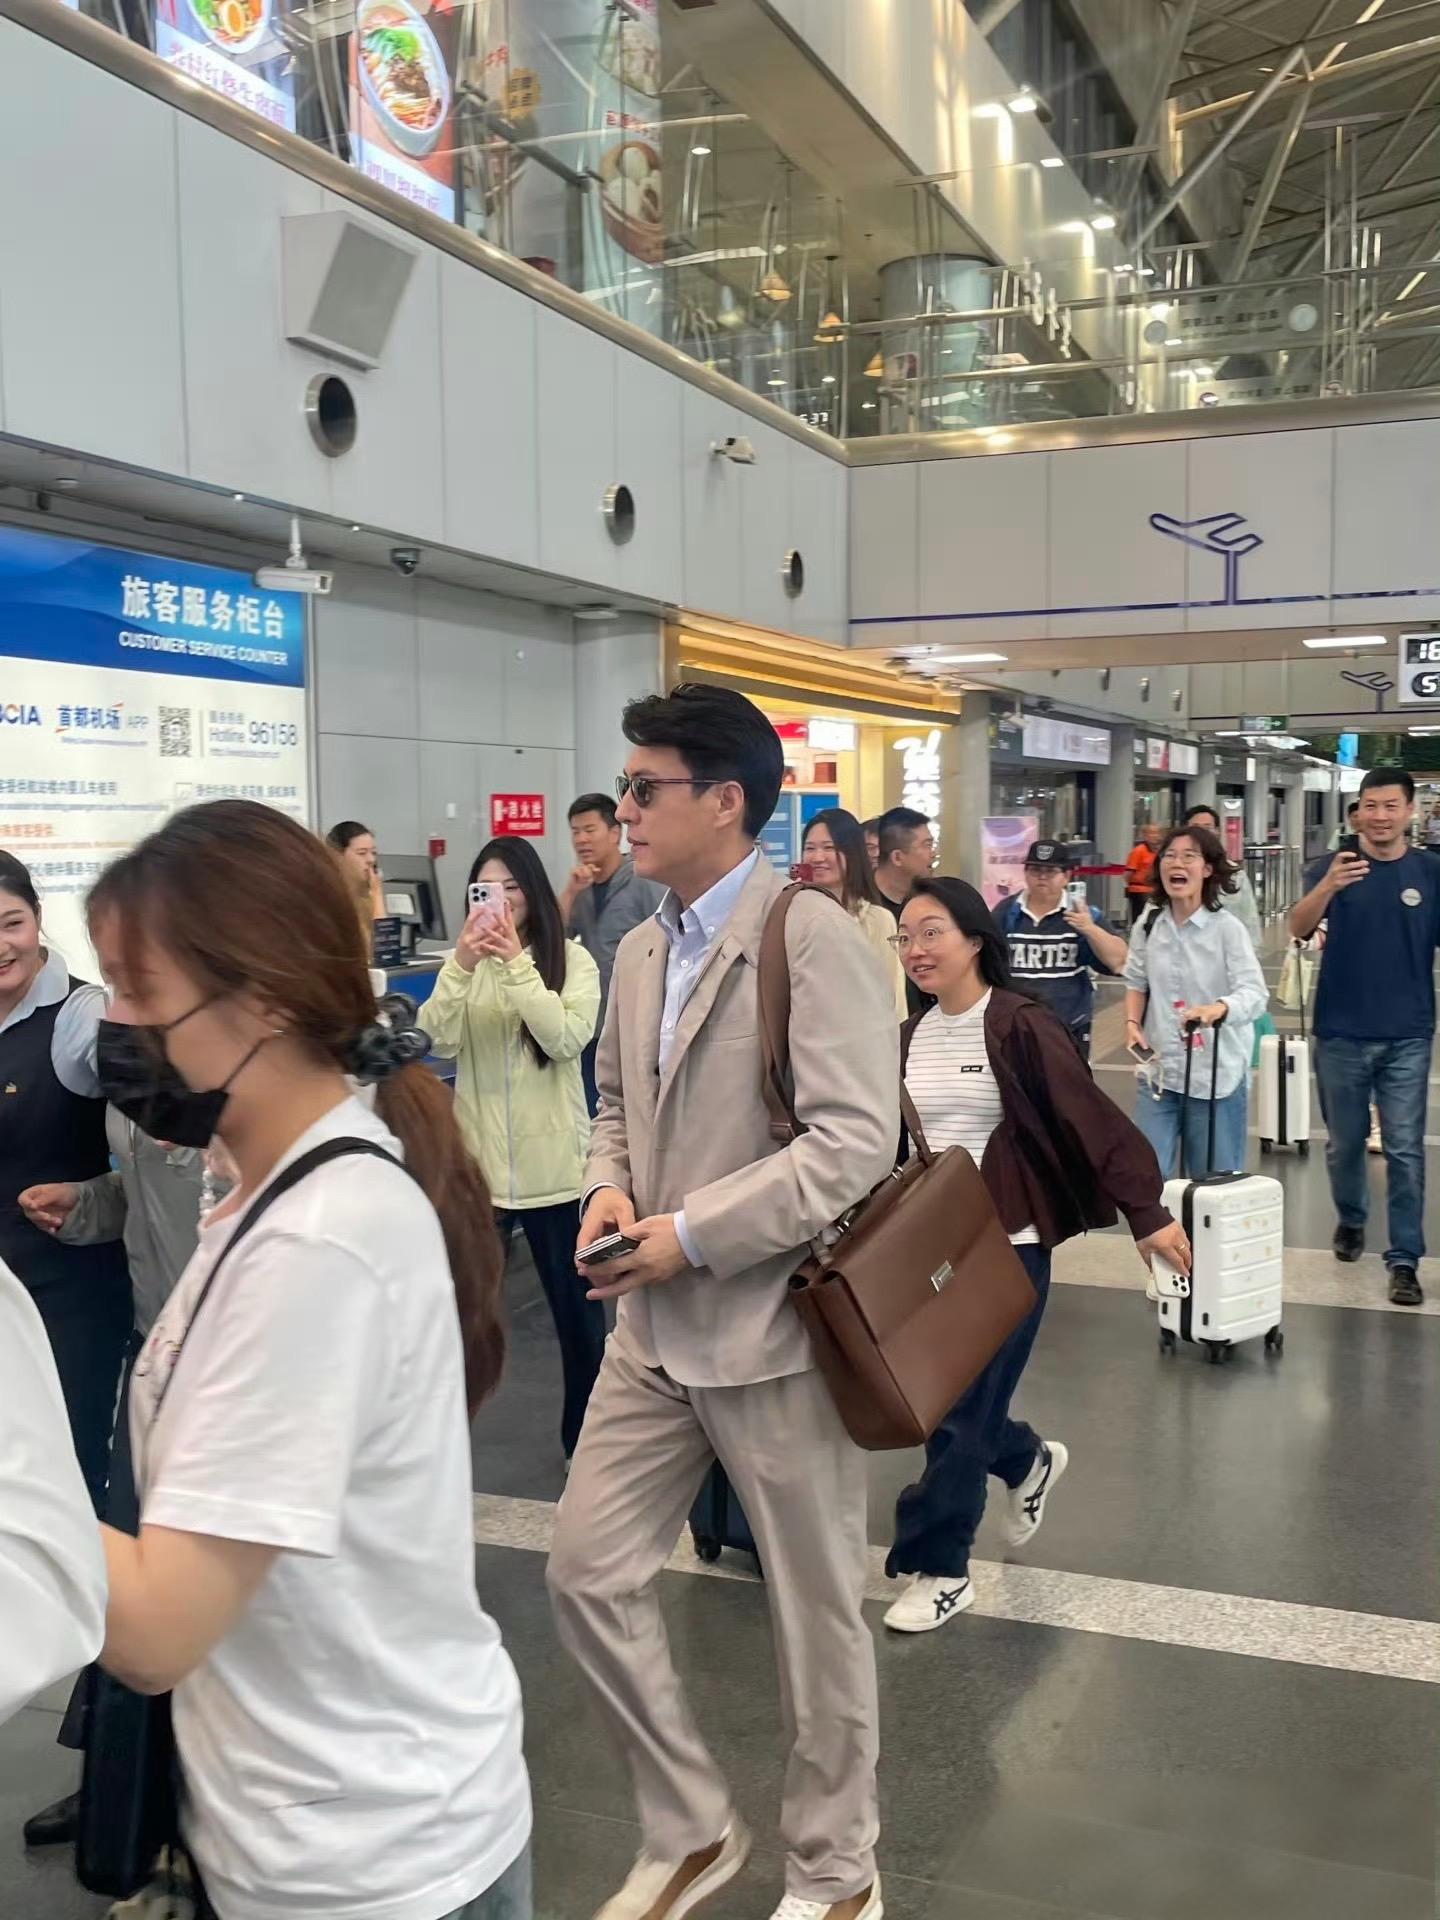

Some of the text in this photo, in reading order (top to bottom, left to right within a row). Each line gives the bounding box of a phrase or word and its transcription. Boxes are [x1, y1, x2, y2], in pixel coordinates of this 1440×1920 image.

[121, 574, 285, 640] 旅客服务柜台
[118, 630, 289, 666] CUSTOMER SERVICE COUNTER
[0, 704, 42, 726] CIA
[58, 704, 121, 731] 首都机场
[248, 721, 297, 747] 96158
